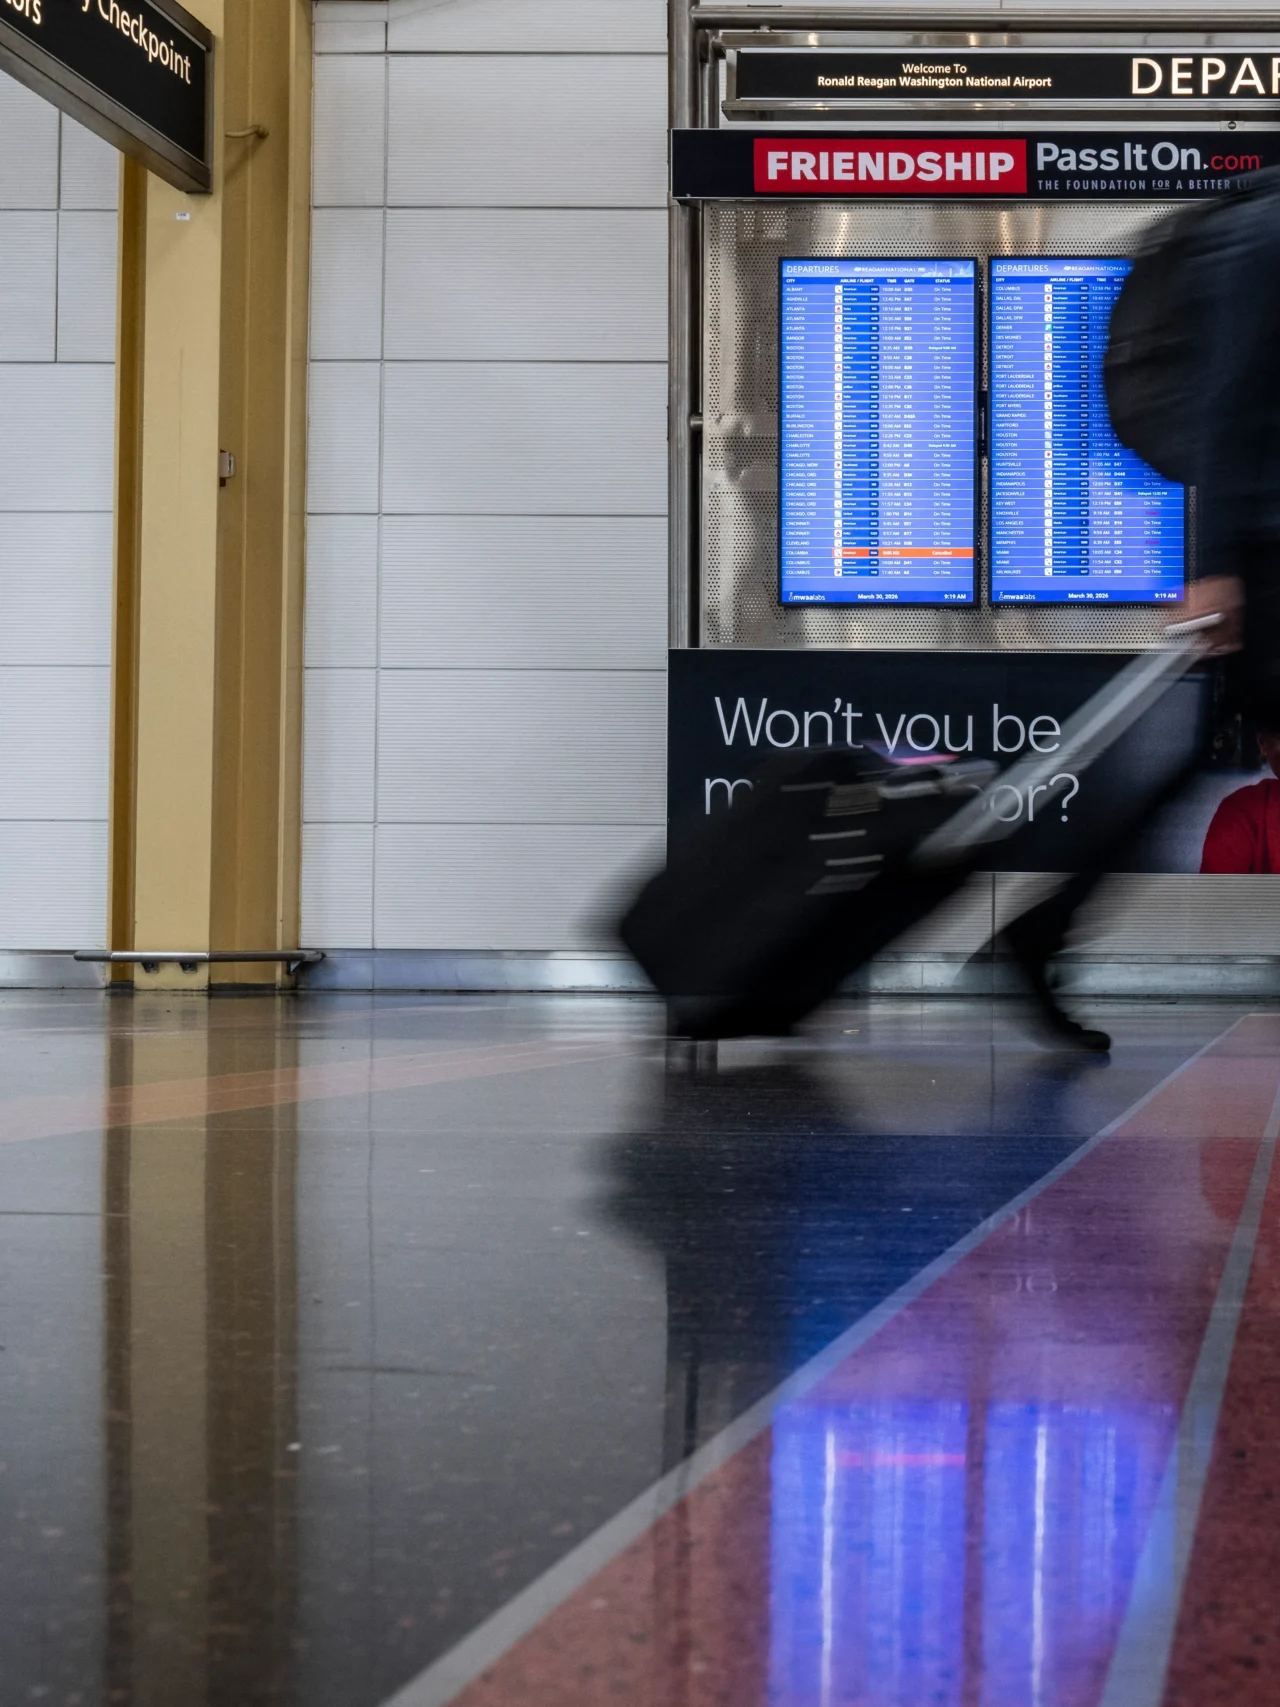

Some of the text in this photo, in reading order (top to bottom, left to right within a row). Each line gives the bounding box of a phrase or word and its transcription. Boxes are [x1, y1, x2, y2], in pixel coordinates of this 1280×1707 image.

[97, 0, 191, 84] Checkpoint
[818, 76, 1051, 89] Ronald Reagan Washington National Airport
[902, 63, 967, 73] Welcome To
[767, 150, 1015, 182] FRIENDSHIP
[1037, 141, 1260, 171] PassItOn.com
[1038, 180, 1059, 190] THE
[1066, 180, 1146, 190] FOUNDATION
[1152, 180, 1170, 191] FOR
[1176, 180, 1183, 190] A
[1189, 180, 1230, 190] BETTER
[876, 713, 973, 754] you
[993, 704, 1061, 753] be
[705, 777, 755, 815] m
